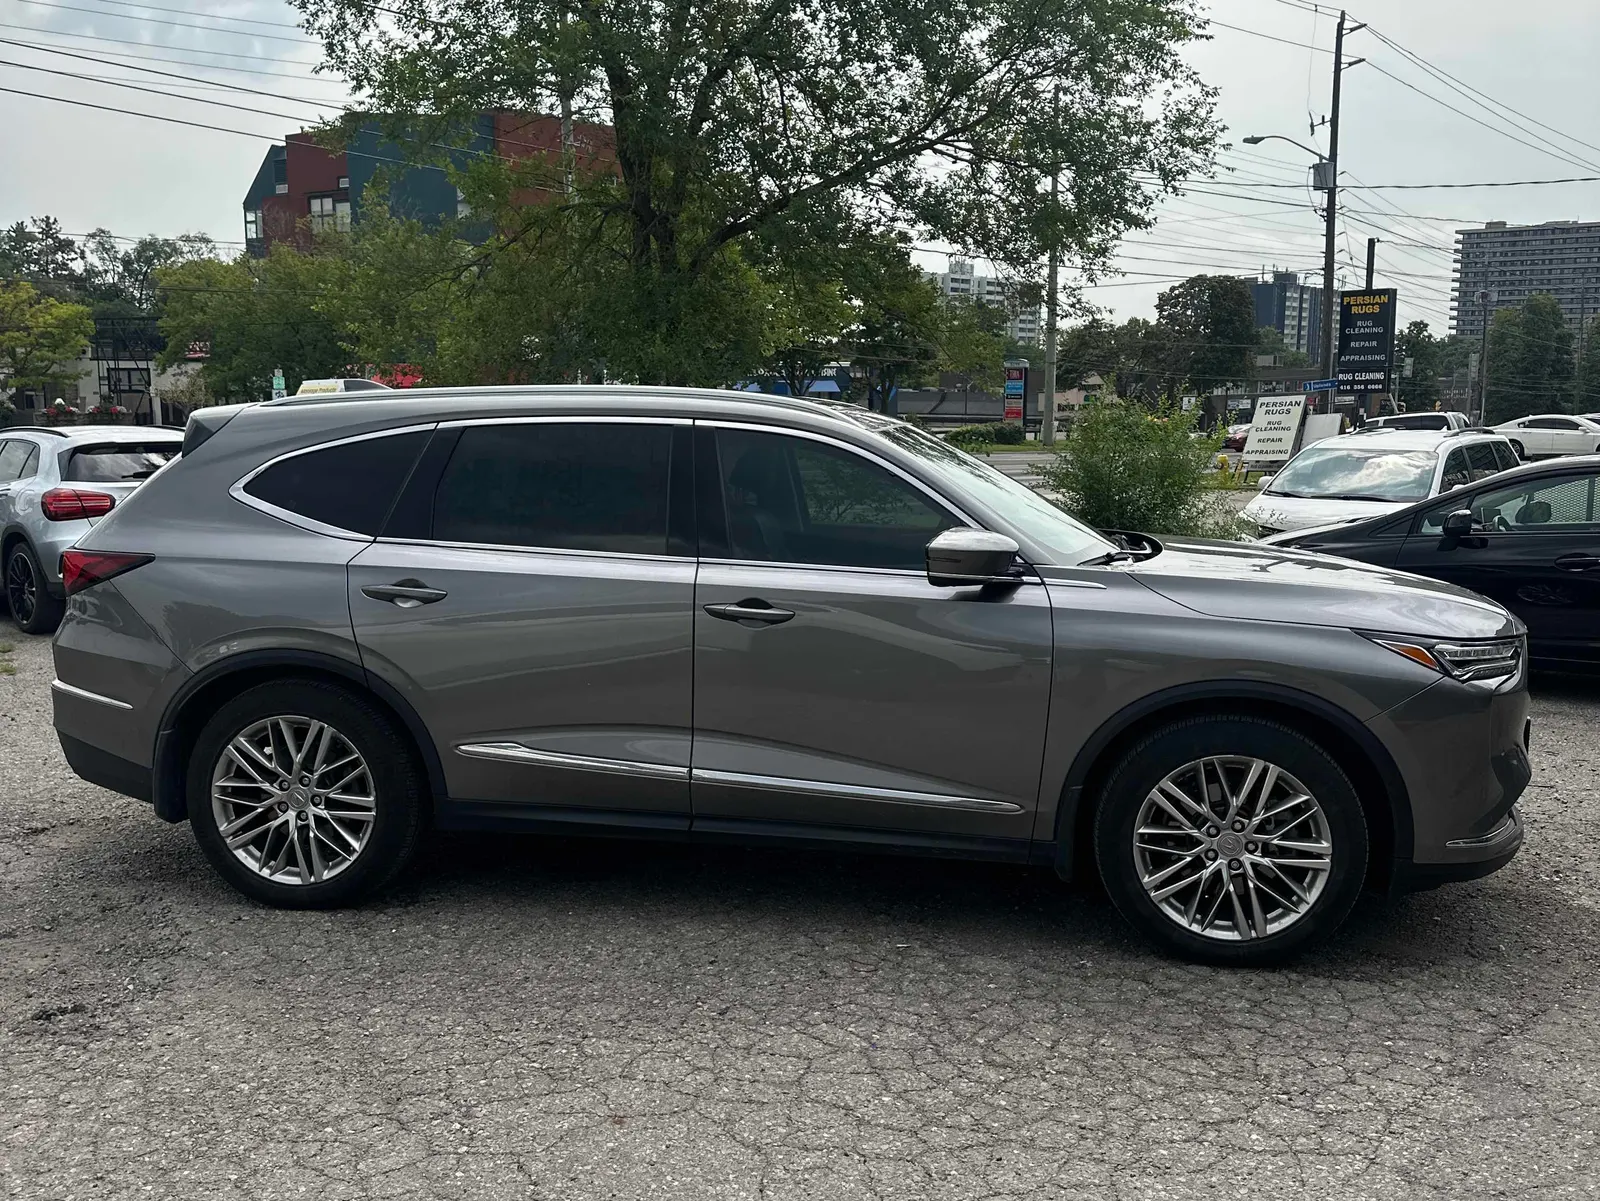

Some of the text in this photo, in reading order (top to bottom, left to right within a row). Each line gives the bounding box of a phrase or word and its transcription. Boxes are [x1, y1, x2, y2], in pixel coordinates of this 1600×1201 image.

[1343, 295, 1388, 305] PERSIAN
[1351, 305, 1380, 314] RUGS
[1354, 372, 1385, 380] CLEANING
[1259, 400, 1301, 408] PERSIAN
